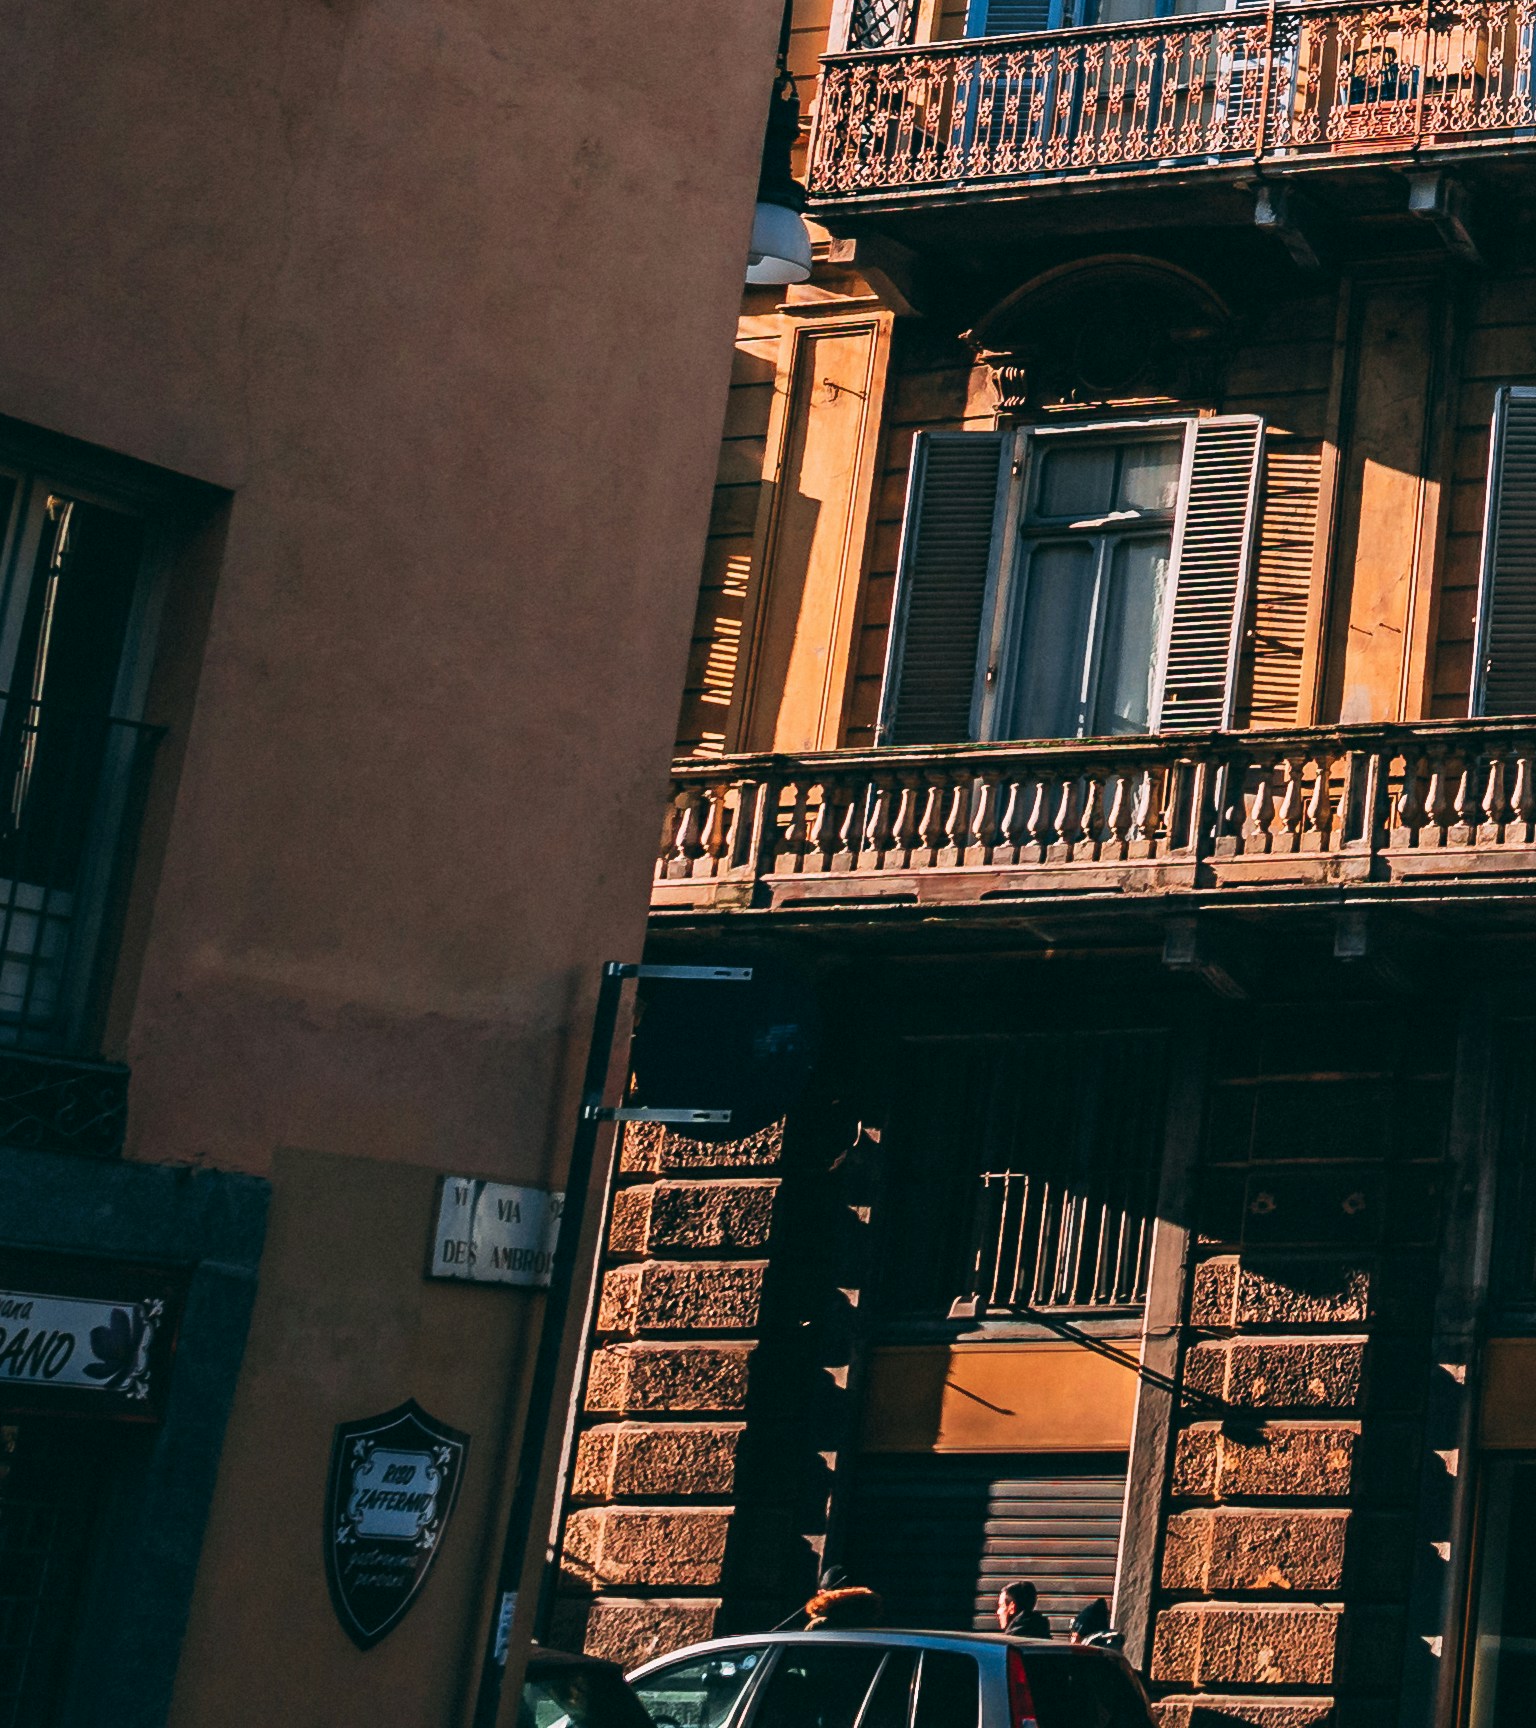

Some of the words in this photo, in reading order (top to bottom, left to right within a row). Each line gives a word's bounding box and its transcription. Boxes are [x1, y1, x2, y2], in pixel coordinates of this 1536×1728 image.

[497, 1198, 521, 1224] VIA
[442, 1239, 478, 1265] DES
[490, 1245, 556, 1274] AMBROI
[355, 1488, 434, 1513] ZAFFERANO
